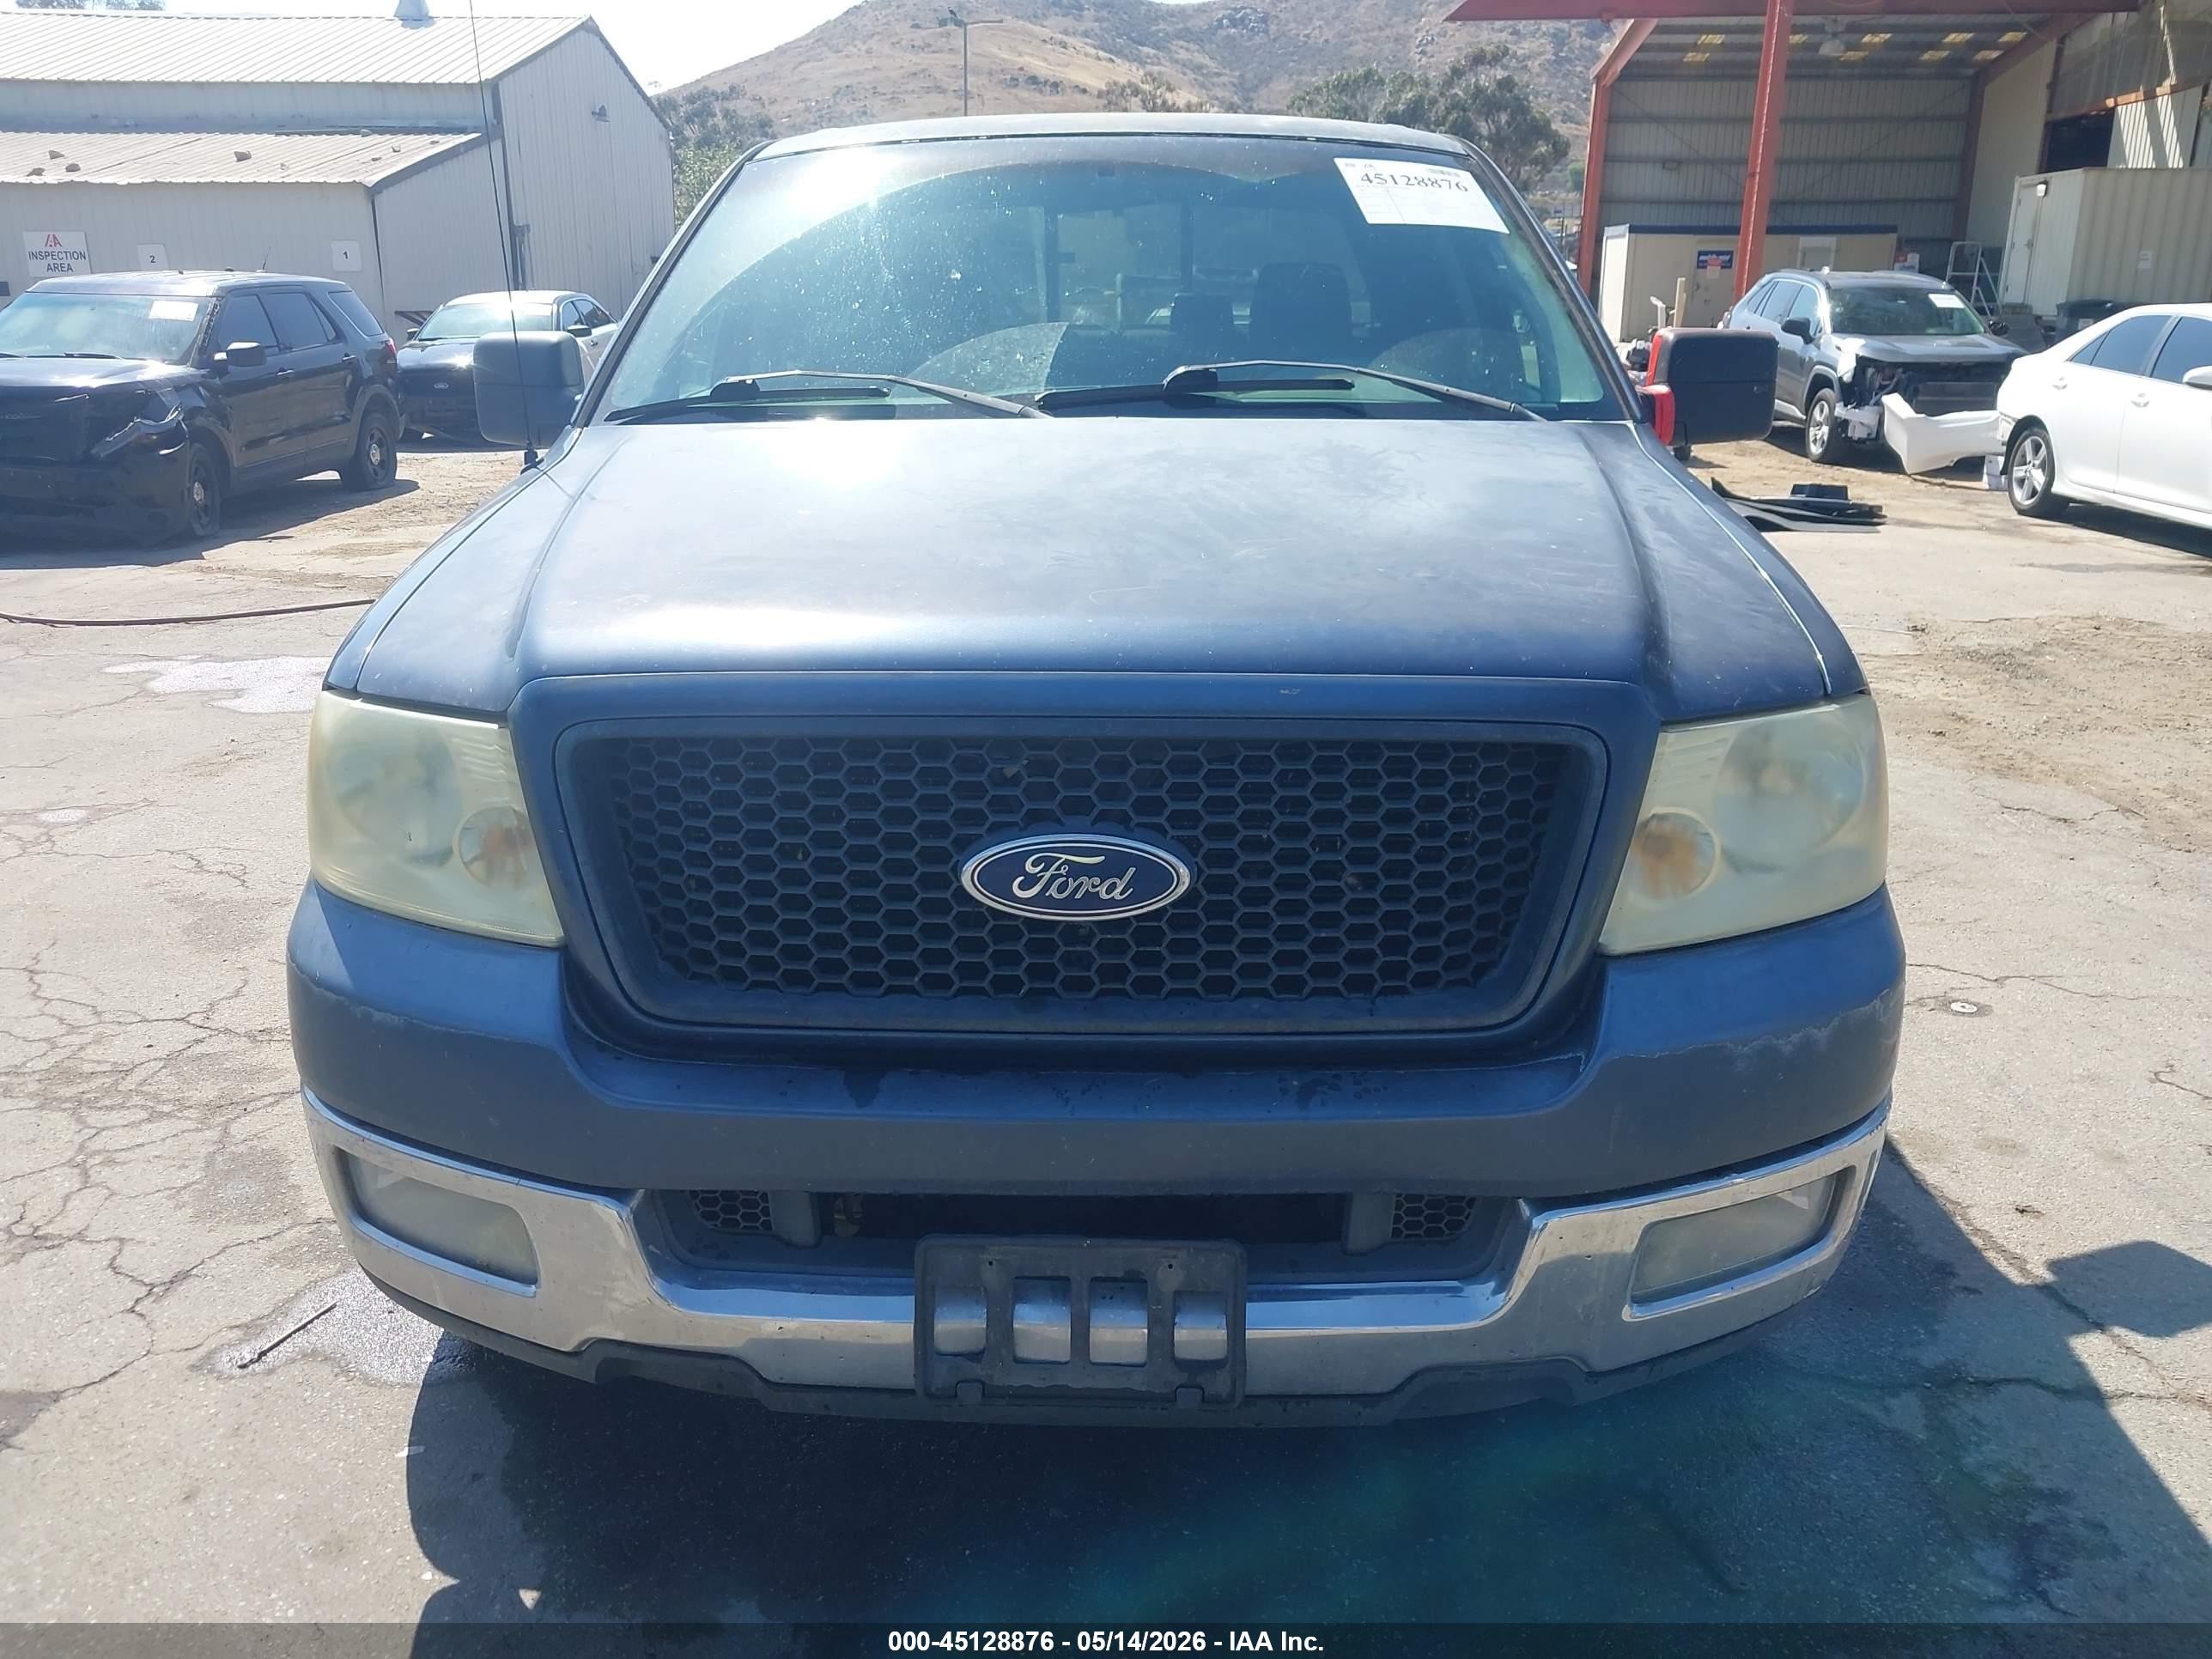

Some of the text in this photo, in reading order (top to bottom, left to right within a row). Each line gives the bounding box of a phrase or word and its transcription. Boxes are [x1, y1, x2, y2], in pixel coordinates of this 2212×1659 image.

[1361, 173, 1468, 192] 45128876
[28, 251, 87, 261] INSPECTION
[149, 255, 156, 264] 2
[343, 251, 349, 259] 1
[46, 263, 74, 272] AREA
[1012, 852, 1136, 900] Ford
